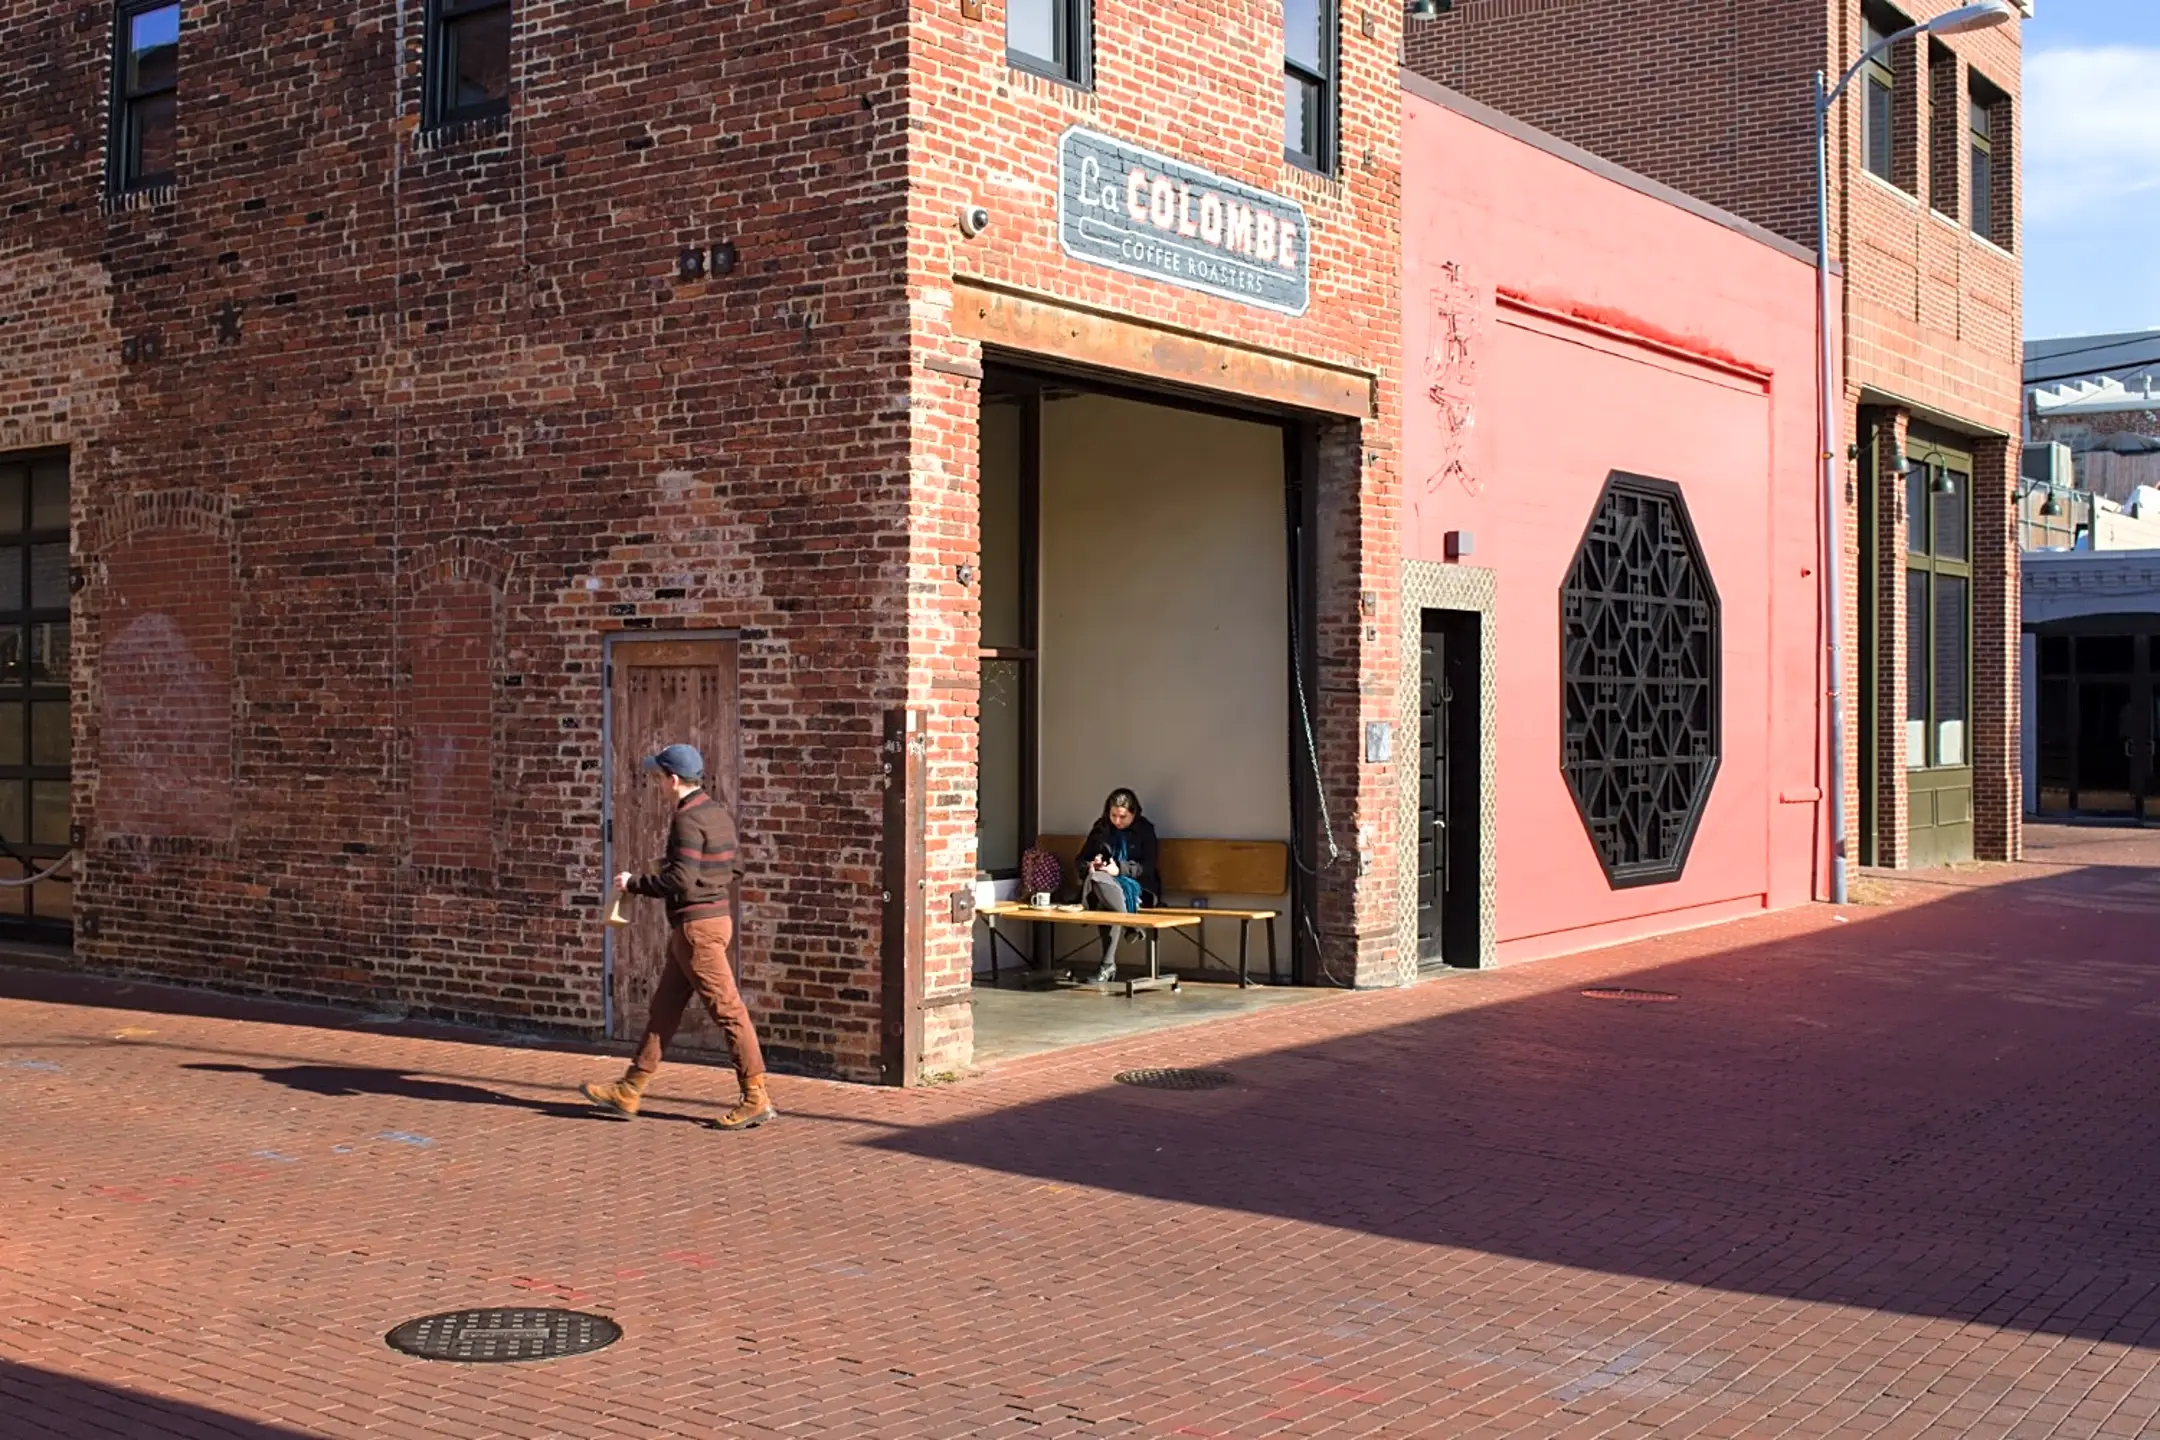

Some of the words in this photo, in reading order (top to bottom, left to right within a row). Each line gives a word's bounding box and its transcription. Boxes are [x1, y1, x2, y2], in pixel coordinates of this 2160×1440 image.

[1077, 155, 1120, 214] La
[1126, 167, 1298, 271] COLOMBE
[1121, 239, 1180, 273] COFFEE
[1188, 256, 1263, 294] ROASTERS
